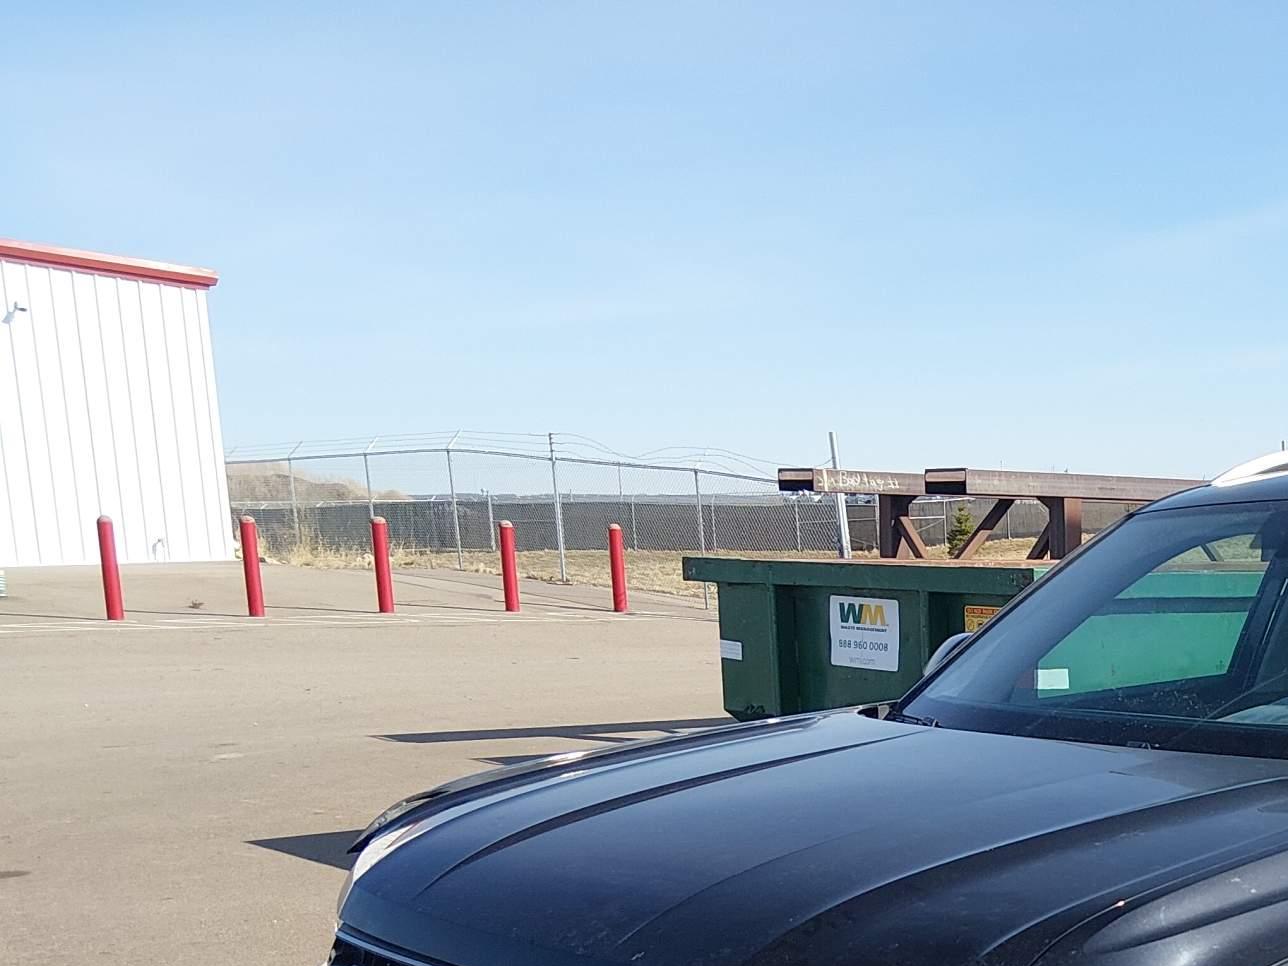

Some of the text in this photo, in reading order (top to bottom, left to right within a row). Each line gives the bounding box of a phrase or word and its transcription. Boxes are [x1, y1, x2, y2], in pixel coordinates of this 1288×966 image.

[839, 602, 886, 625] WM
[838, 639, 889, 652] 888 960 0008
